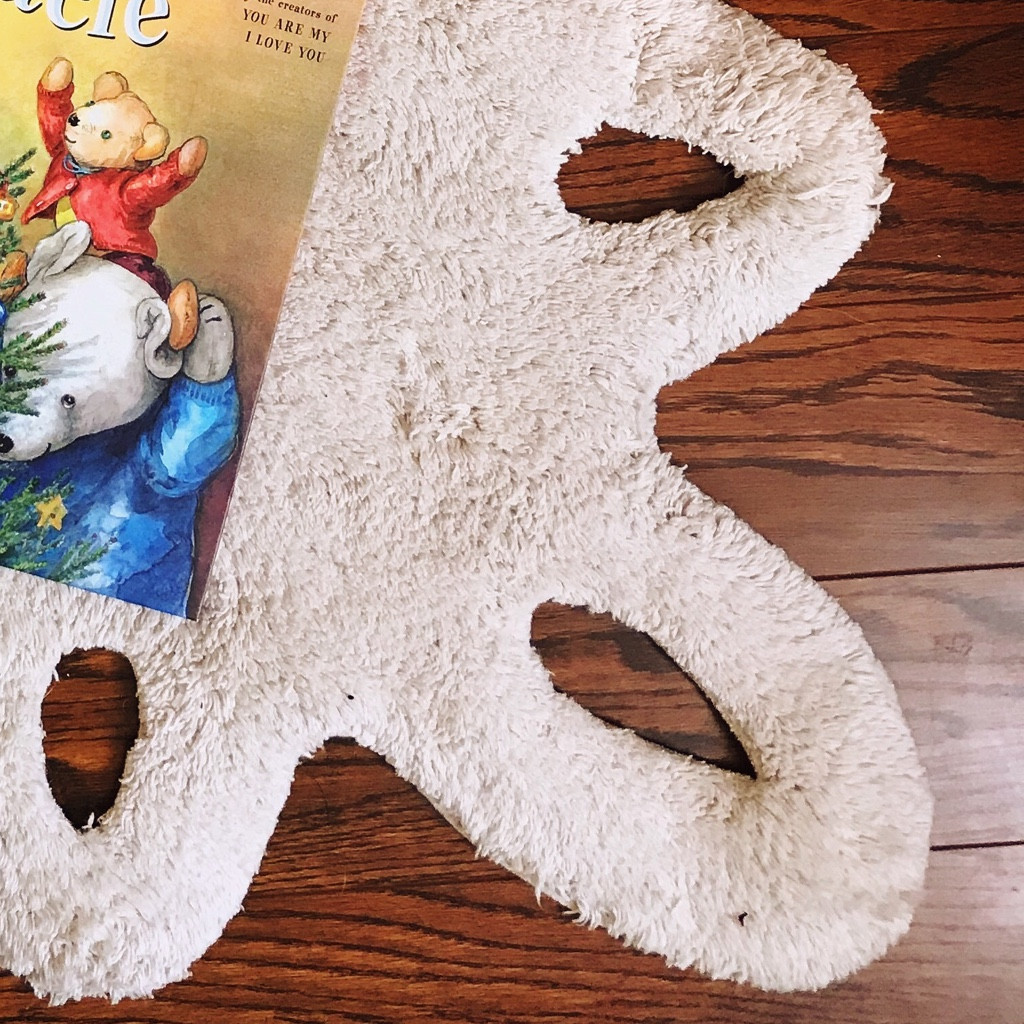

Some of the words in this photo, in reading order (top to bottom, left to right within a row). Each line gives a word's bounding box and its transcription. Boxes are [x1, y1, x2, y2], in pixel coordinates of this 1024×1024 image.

[243, 8, 270, 26] YOU
[275, 18, 304, 36] ARE
[308, 27, 333, 43] MY
[278, 0, 322, 19] creators
[325, 13, 339, 24] of
[245, 31, 252, 43] I
[256, 33, 292, 55] LOVE
[299, 46, 328, 64] YOU
